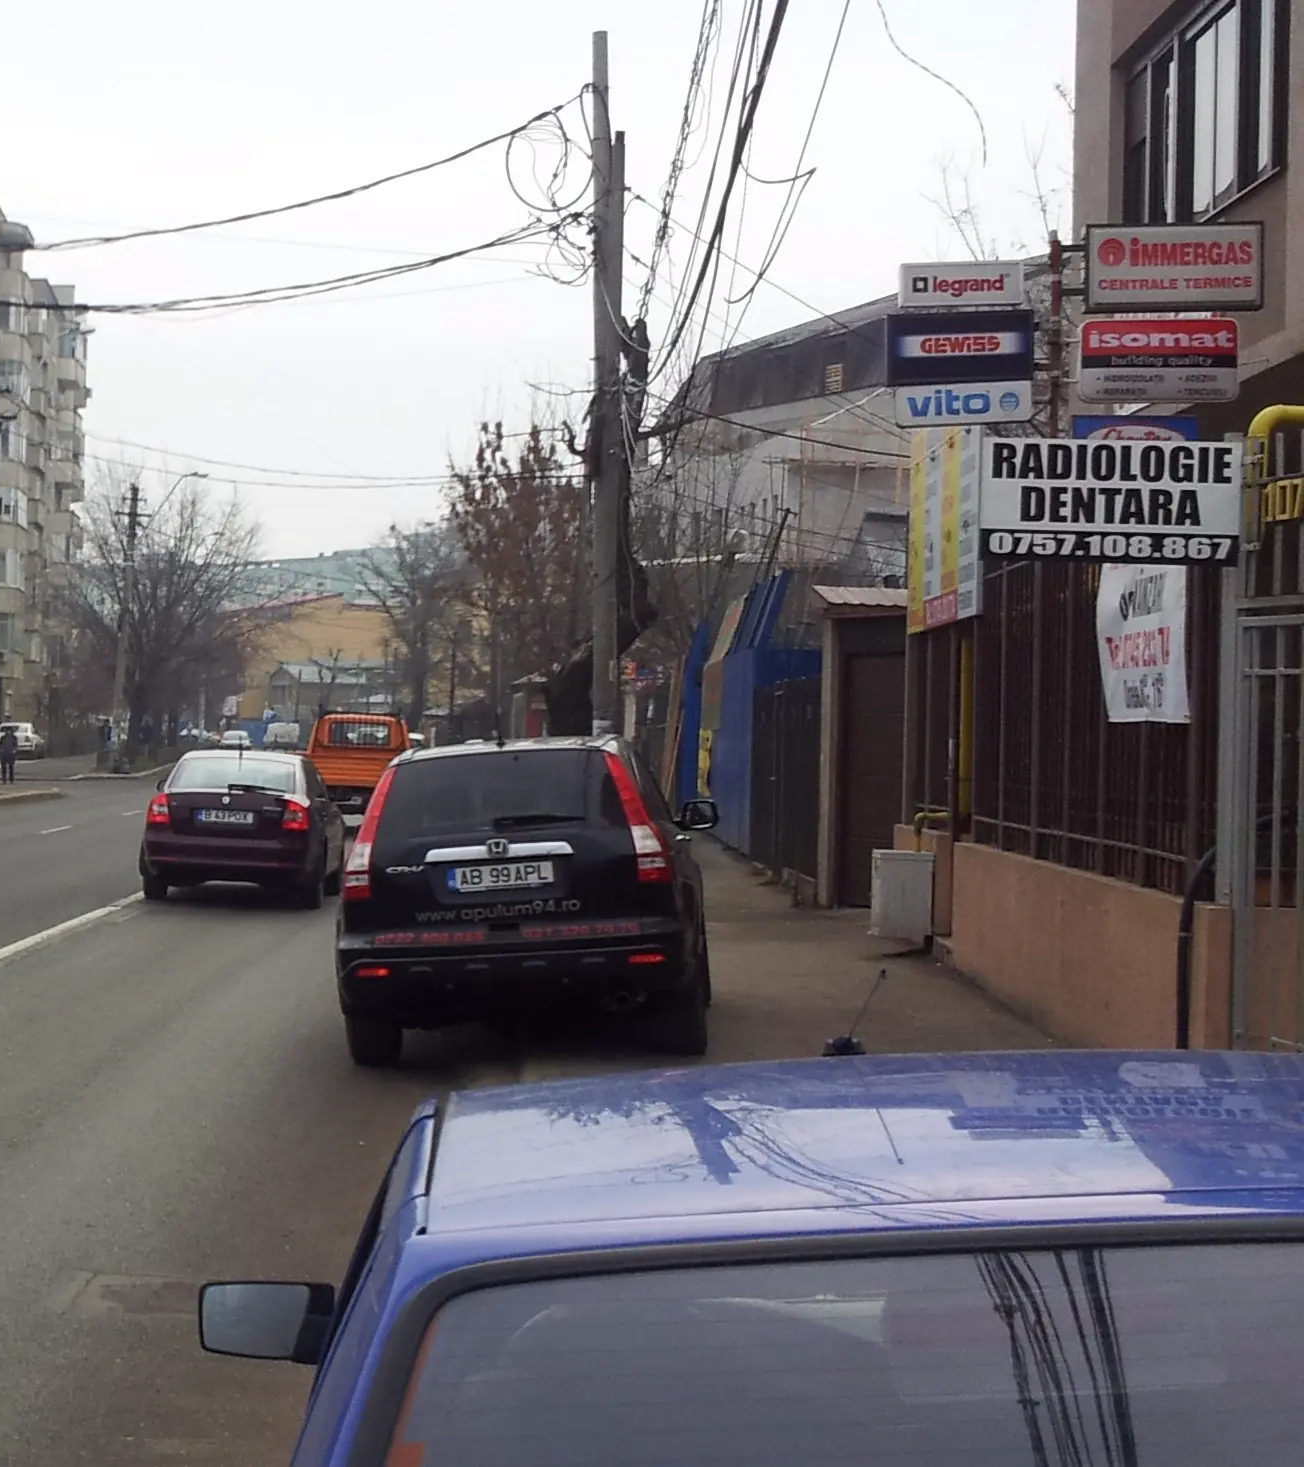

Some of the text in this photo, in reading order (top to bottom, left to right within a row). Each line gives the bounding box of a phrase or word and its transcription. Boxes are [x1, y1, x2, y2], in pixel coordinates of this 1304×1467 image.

[932, 274, 1005, 298] legrand
[1098, 276, 1253, 291] CENTRALE TERMICE
[1089, 330, 1234, 349] isomat
[1111, 356, 1213, 367] building quality
[906, 389, 991, 418] vito
[991, 443, 1233, 484] RADIOLOGIE
[1019, 486, 1201, 526] DENTARA
[989, 532, 1232, 560] 0757.108.867
[460, 861, 548, 887] AB 99 APL
